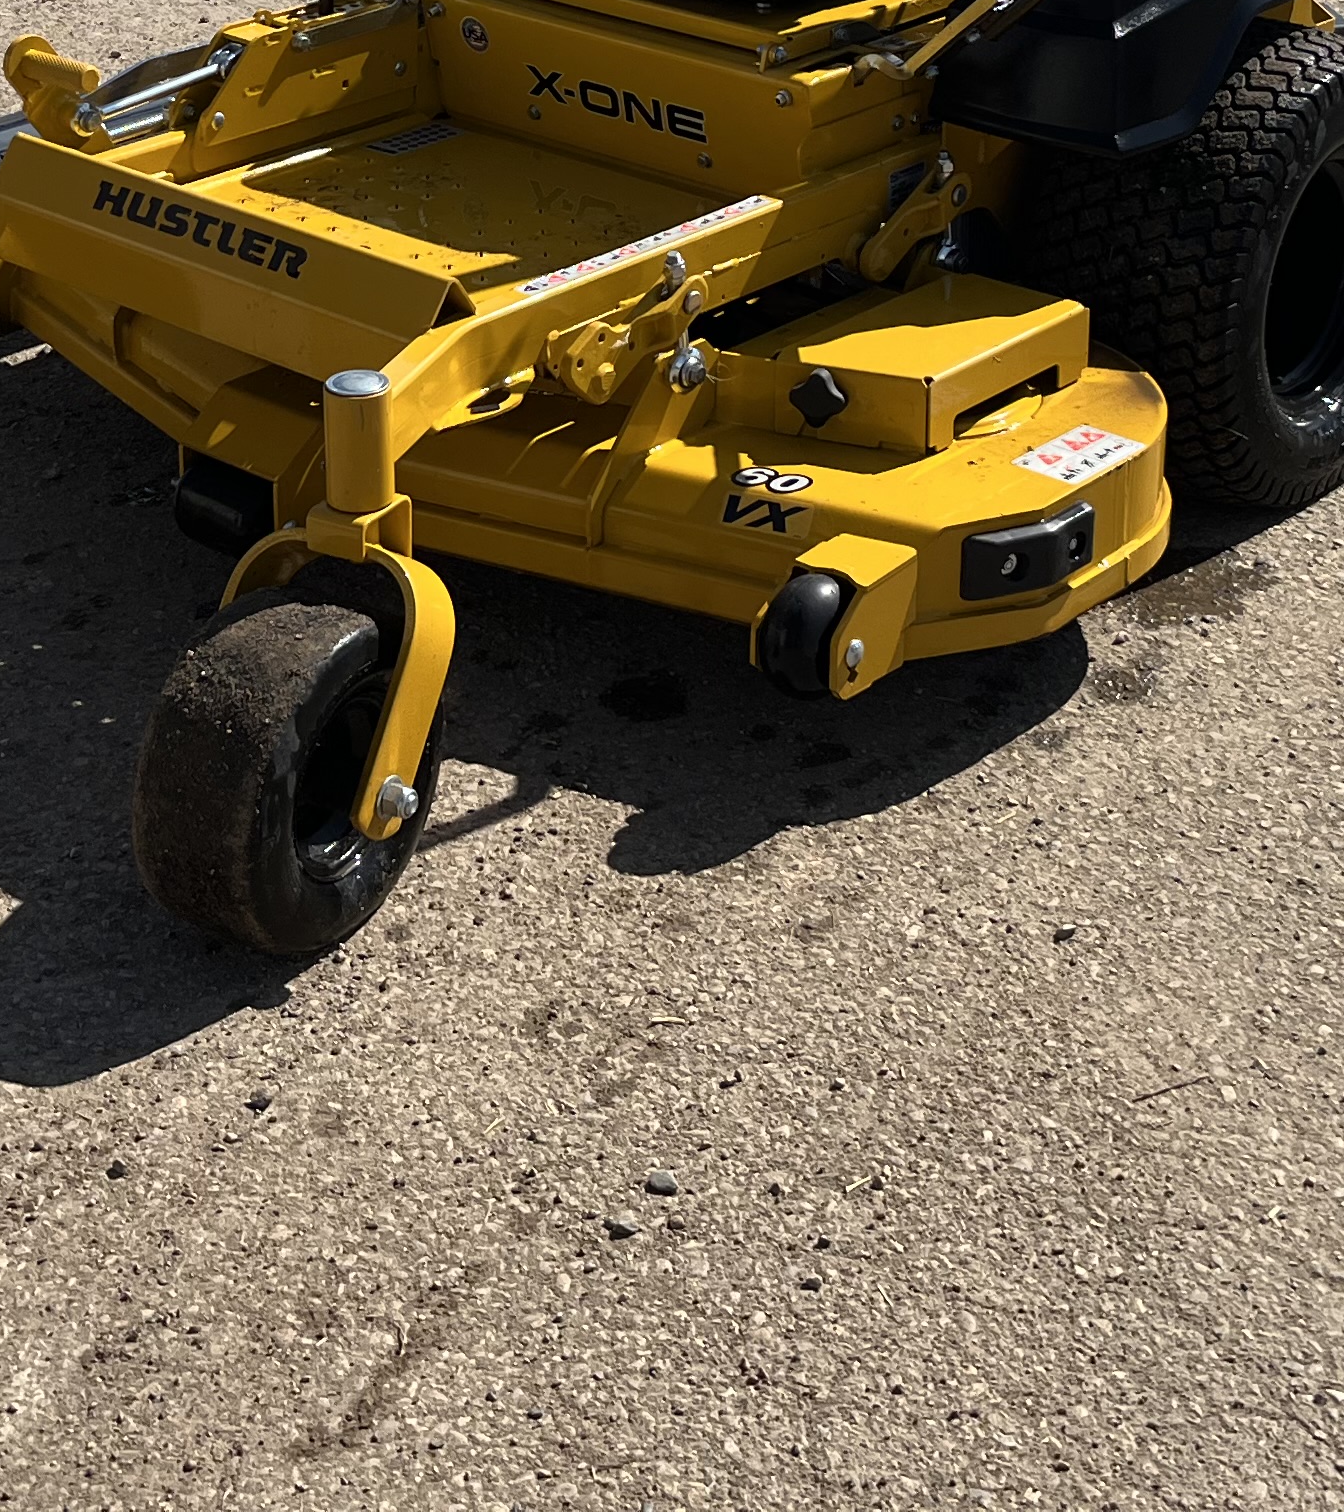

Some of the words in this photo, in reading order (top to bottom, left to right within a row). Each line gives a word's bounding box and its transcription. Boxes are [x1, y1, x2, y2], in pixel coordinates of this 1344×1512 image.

[526, 64, 708, 144] X-ONE
[92, 180, 309, 280] HUSTLER
[731, 467, 814, 494] 60
[722, 494, 809, 534] VX
